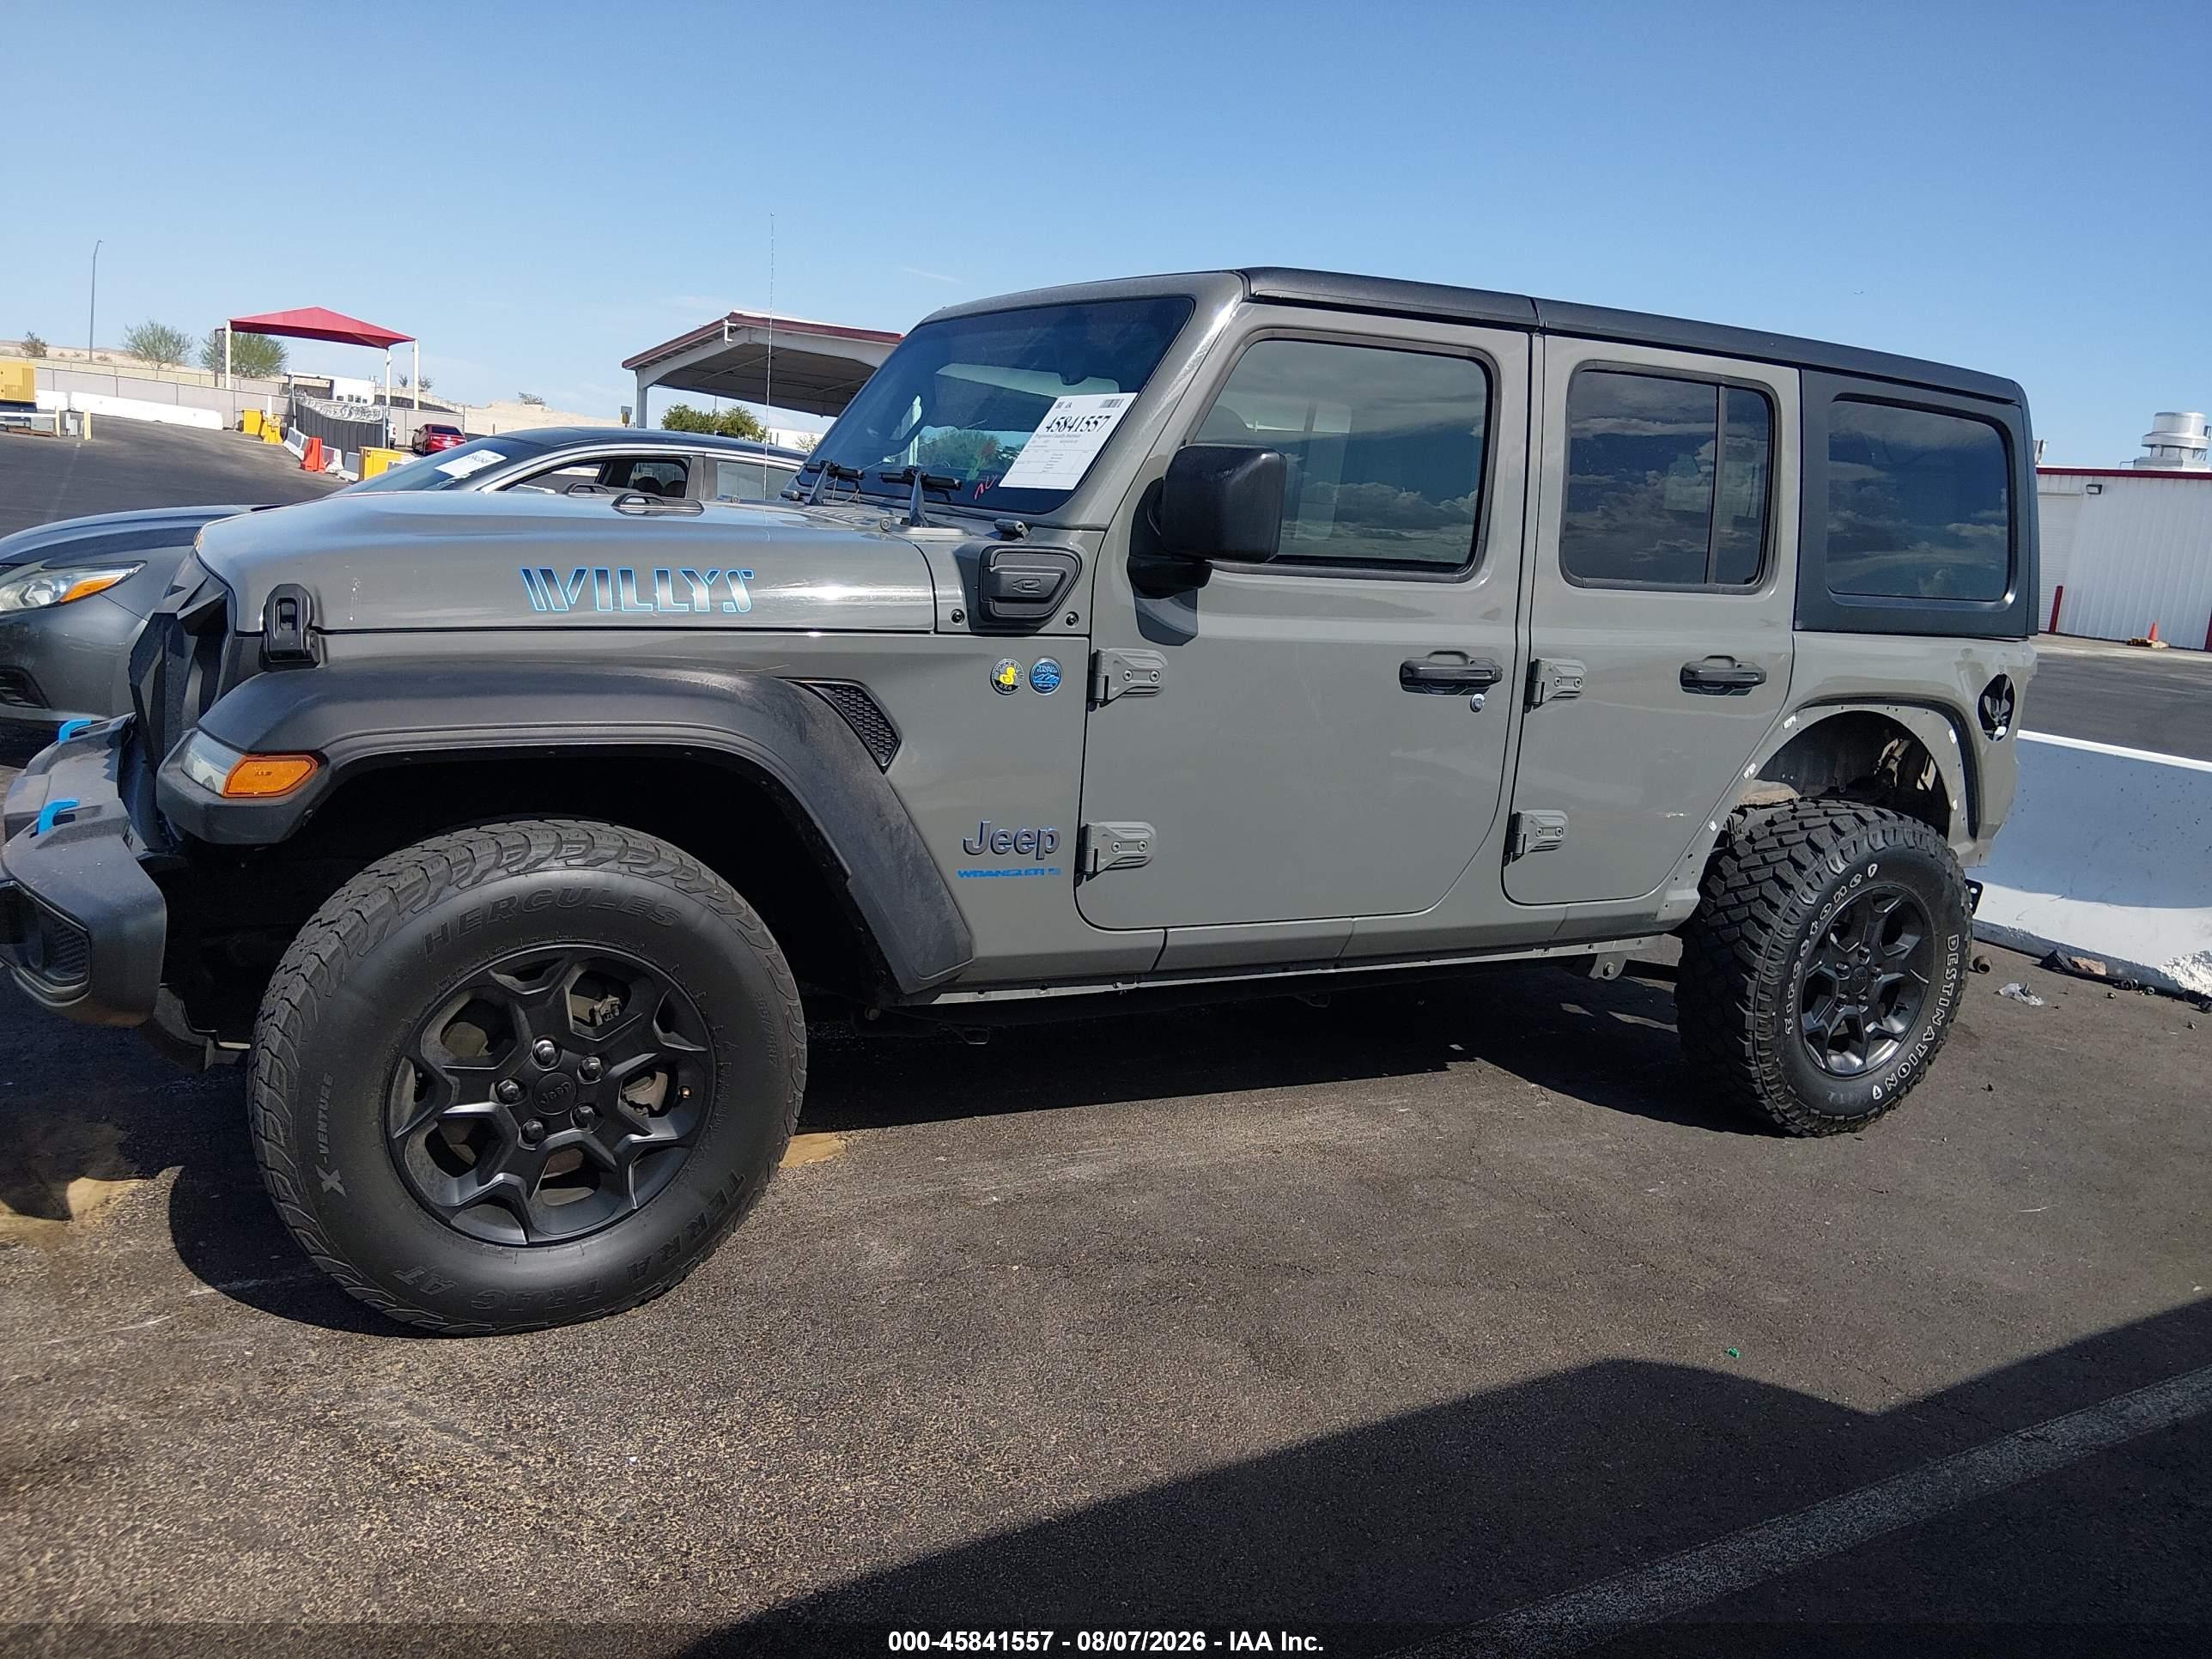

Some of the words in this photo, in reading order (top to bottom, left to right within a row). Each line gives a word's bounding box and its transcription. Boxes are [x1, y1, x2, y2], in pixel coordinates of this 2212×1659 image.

[1045, 416, 1112, 432] 45841557
[521, 568, 756, 612] WILLYS
[963, 820, 1060, 860] Jeep
[419, 886, 681, 955] HERCULES
[1884, 933, 1960, 1092] DESTINATION
